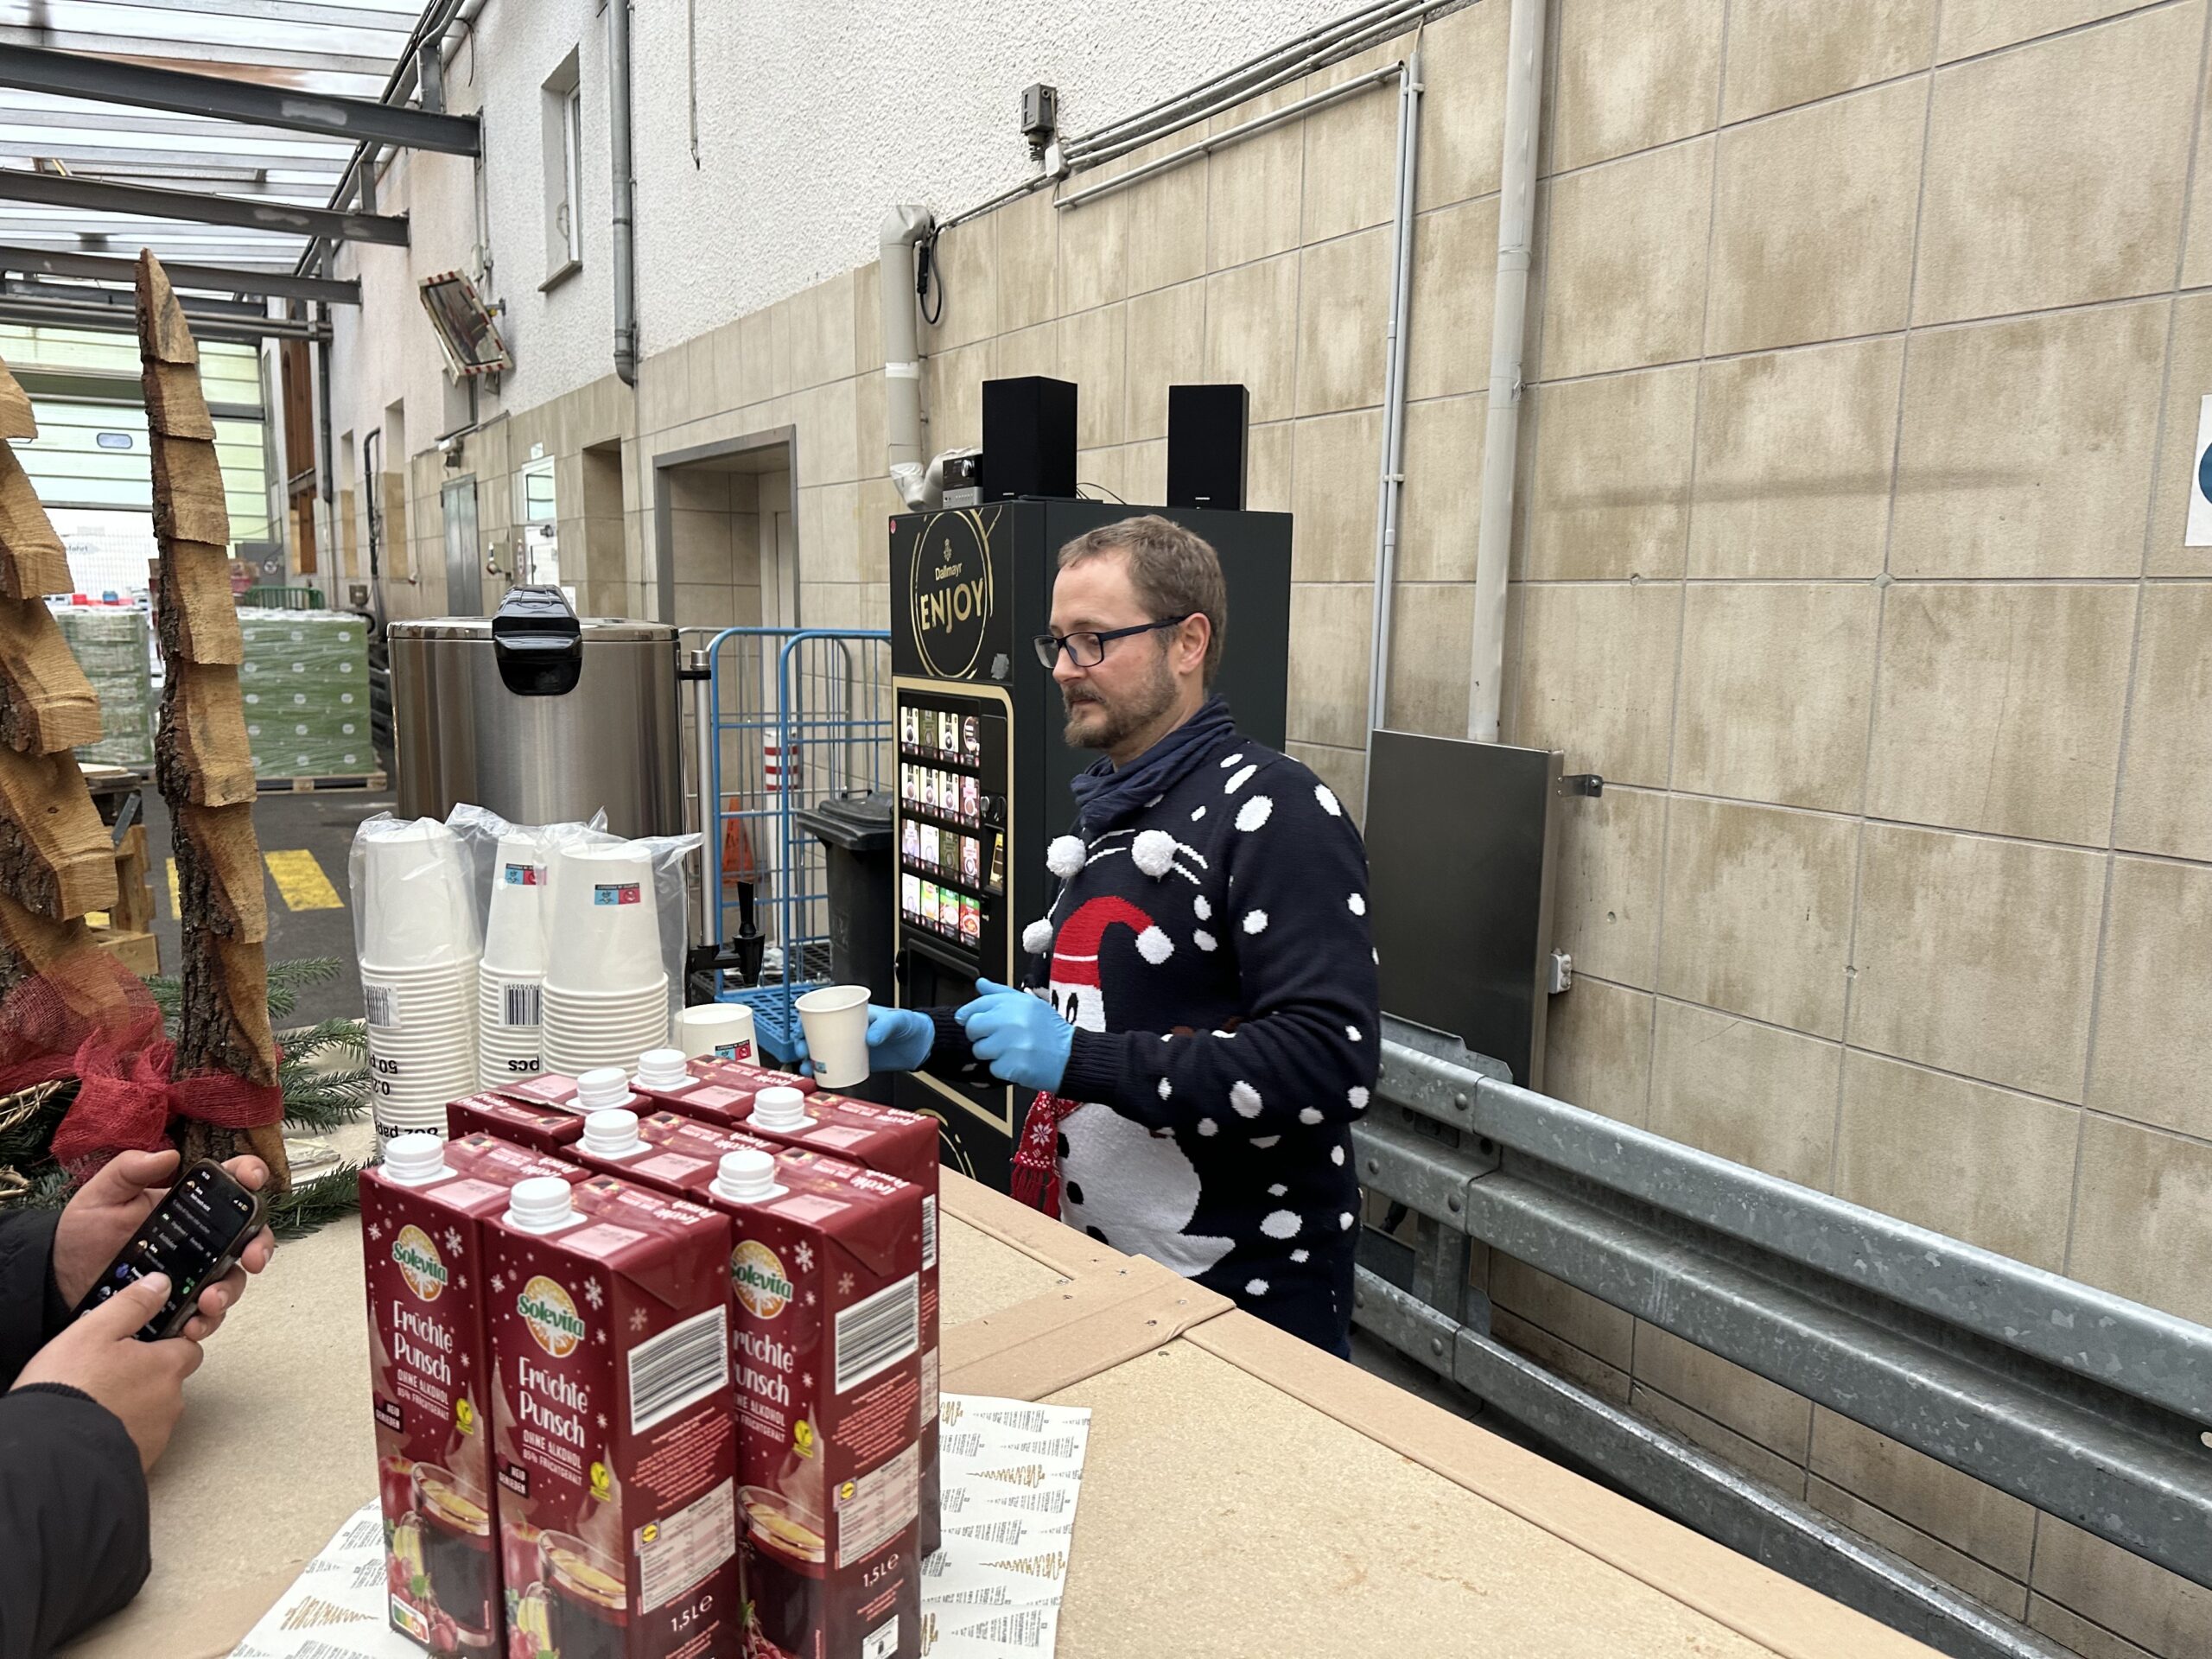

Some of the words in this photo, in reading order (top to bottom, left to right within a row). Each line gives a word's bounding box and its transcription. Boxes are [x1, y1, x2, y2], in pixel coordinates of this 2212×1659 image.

[935, 562, 963, 581] Dallmayr
[920, 577, 983, 633] ENJOY
[379, 1059, 398, 1074] 50
[508, 1056, 540, 1071] pcs
[374, 1122, 398, 1139] pap
[393, 1242, 447, 1283] Solevita
[393, 1300, 453, 1353] Früchte
[518, 1294, 583, 1338] Solevita
[394, 1332, 451, 1386] Punsch
[733, 1330, 794, 1374] rüchte
[397, 1369, 418, 1388] OHNE
[418, 1379, 449, 1405] ALKOHOL
[518, 1356, 588, 1414] Früchte
[733, 1360, 790, 1407] unsch
[519, 1390, 585, 1448] Punsch
[749, 1400, 786, 1427] ALKOHOL
[523, 1429, 546, 1450] OHNE
[547, 1441, 582, 1470] ALKOHOL
